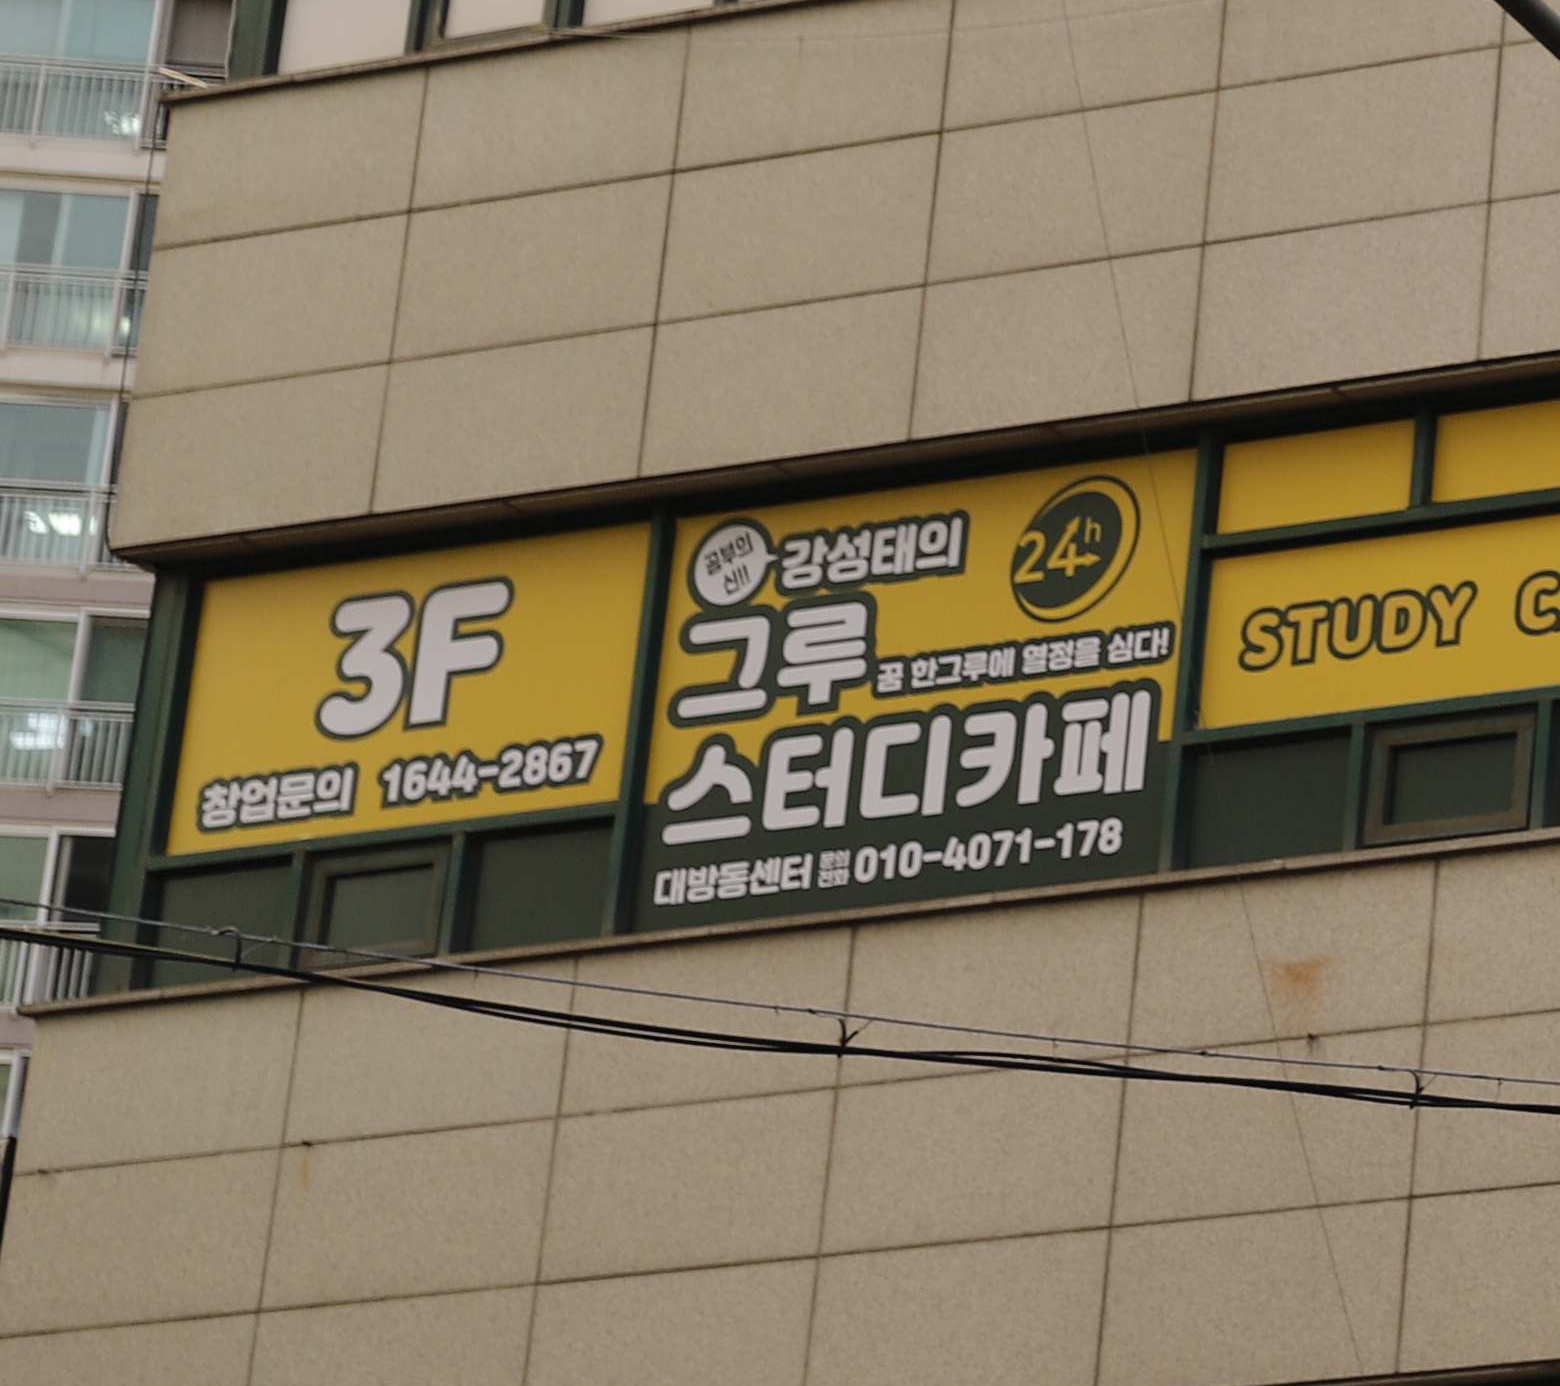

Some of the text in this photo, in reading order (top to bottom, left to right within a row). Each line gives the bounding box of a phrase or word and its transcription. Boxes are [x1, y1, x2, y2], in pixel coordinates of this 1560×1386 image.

[702, 531, 753, 576] 공부의
[781, 514, 968, 593] 강성태의
[316, 579, 513, 740] 3F
[675, 601, 868, 719] 그루
[911, 647, 1013, 690] 한그루에
[1021, 634, 1101, 677] 열정을
[1107, 627, 1170, 665] 심다!
[1239, 580, 1479, 672] STUDY
[200, 737, 602, 830] 창업문의 1644-2867
[661, 689, 1152, 846] 스터디카페
[653, 854, 813, 907] 대방동센터
[854, 816, 1123, 884] 010-4071-178
